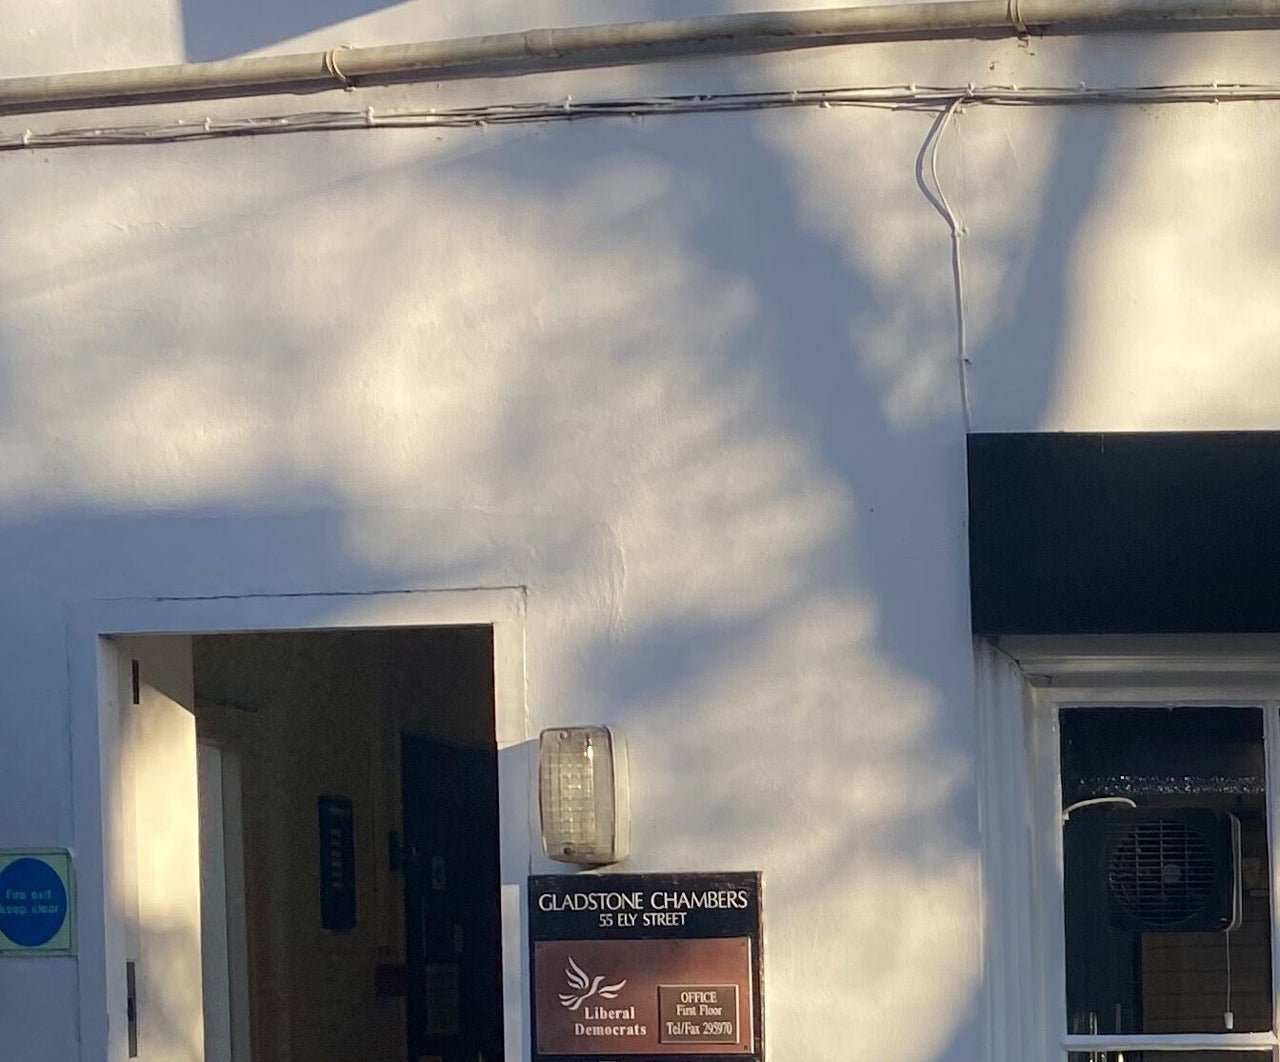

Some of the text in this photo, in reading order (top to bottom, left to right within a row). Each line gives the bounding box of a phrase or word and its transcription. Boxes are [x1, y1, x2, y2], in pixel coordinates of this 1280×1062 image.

[538, 890, 748, 912] GLADSTONE CHAMBERS
[31, 903, 59, 914] clear
[599, 911, 688, 927] 55 ELY STREET
[680, 991, 718, 1004] OFFICE
[584, 1006, 636, 1020] Liberal
[676, 1004, 723, 1016] First Floor
[575, 1023, 647, 1036] Democrats
[666, 1021, 700, 1035] Tel/Fax
